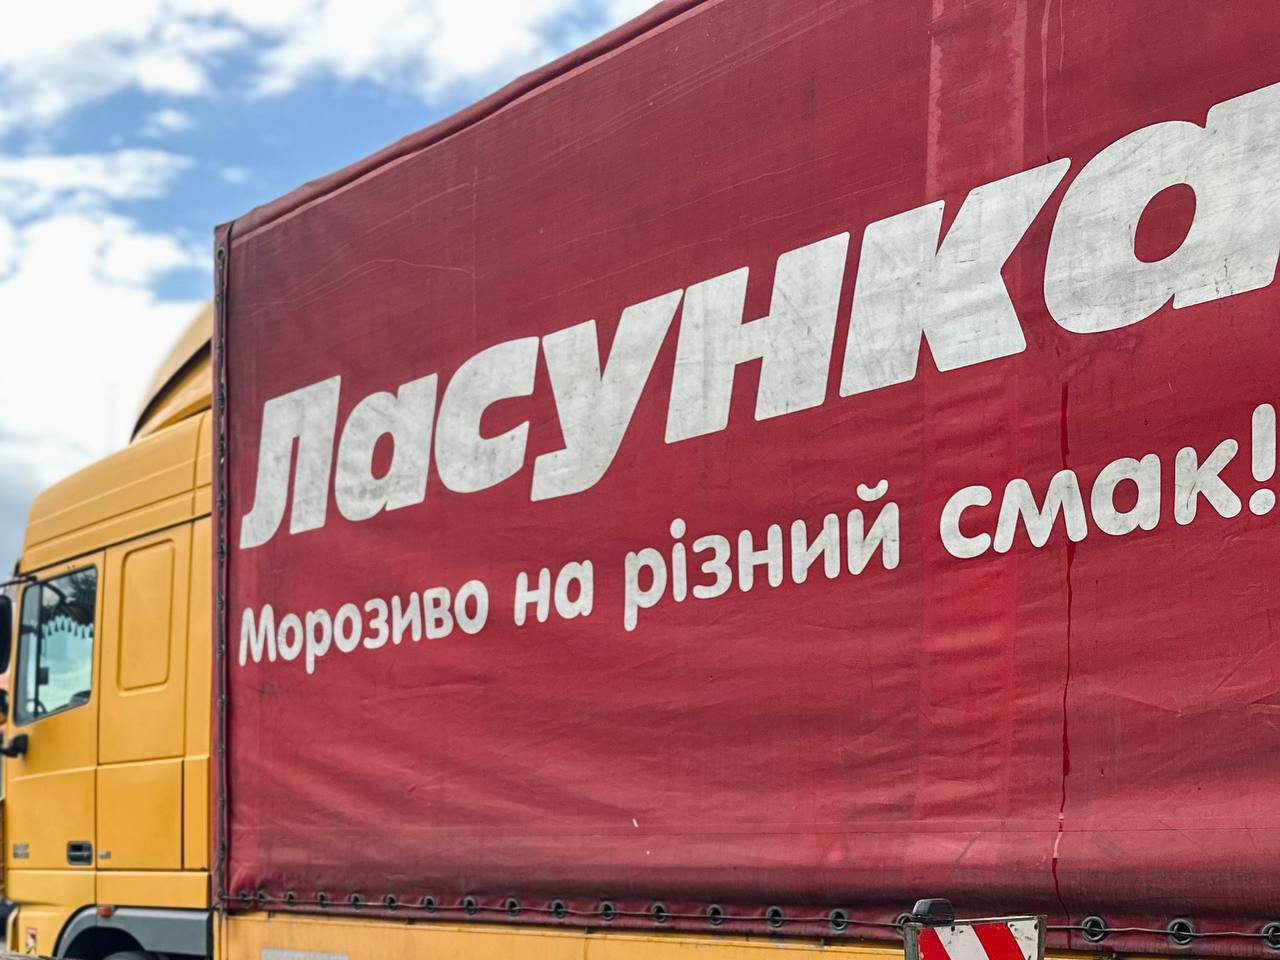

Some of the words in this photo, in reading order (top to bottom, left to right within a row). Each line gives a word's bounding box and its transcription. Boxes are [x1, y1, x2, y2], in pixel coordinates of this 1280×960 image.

[238, 81, 1280, 550] Ласунка
[238, 579, 490, 675] Морозиво
[513, 559, 594, 627] на
[623, 479, 900, 632] різний
[939, 403, 1277, 559] смак!
